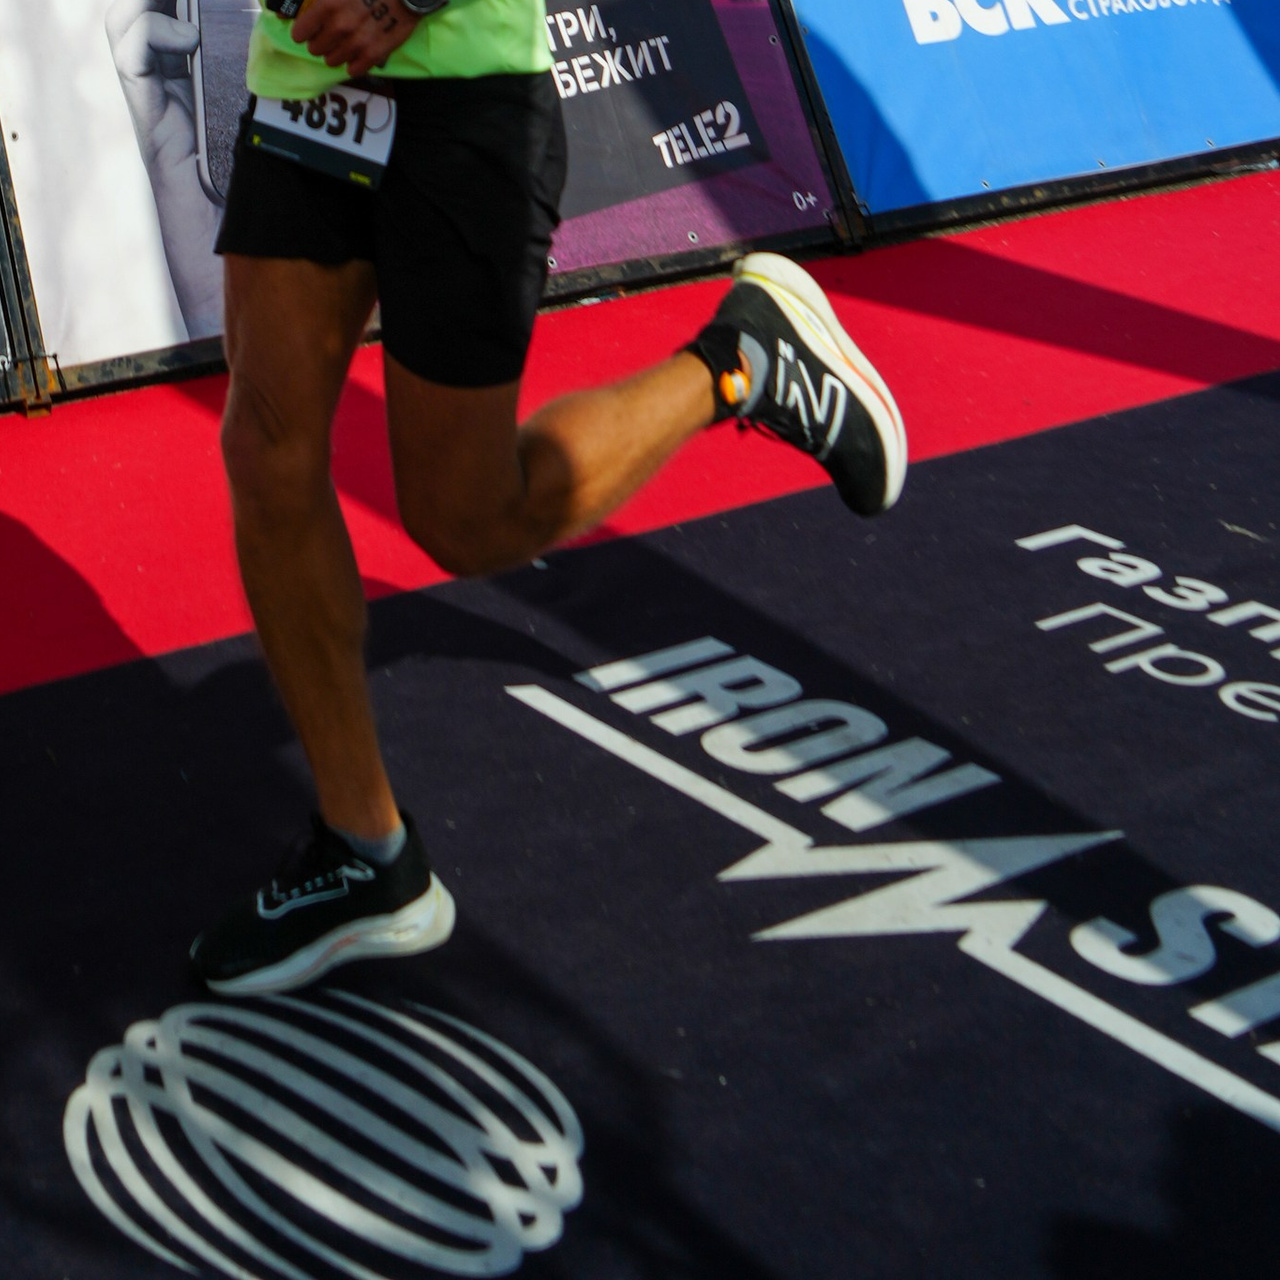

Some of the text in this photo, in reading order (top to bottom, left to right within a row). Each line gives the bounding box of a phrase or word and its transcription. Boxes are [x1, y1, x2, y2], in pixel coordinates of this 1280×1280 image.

[550, 35, 672, 99] БЕЖИТ
[652, 100, 751, 169] TELE2
[792, 190, 818, 212] 0+
[1014, 524, 1280, 662] Газп
[573, 636, 1001, 831] IRON
